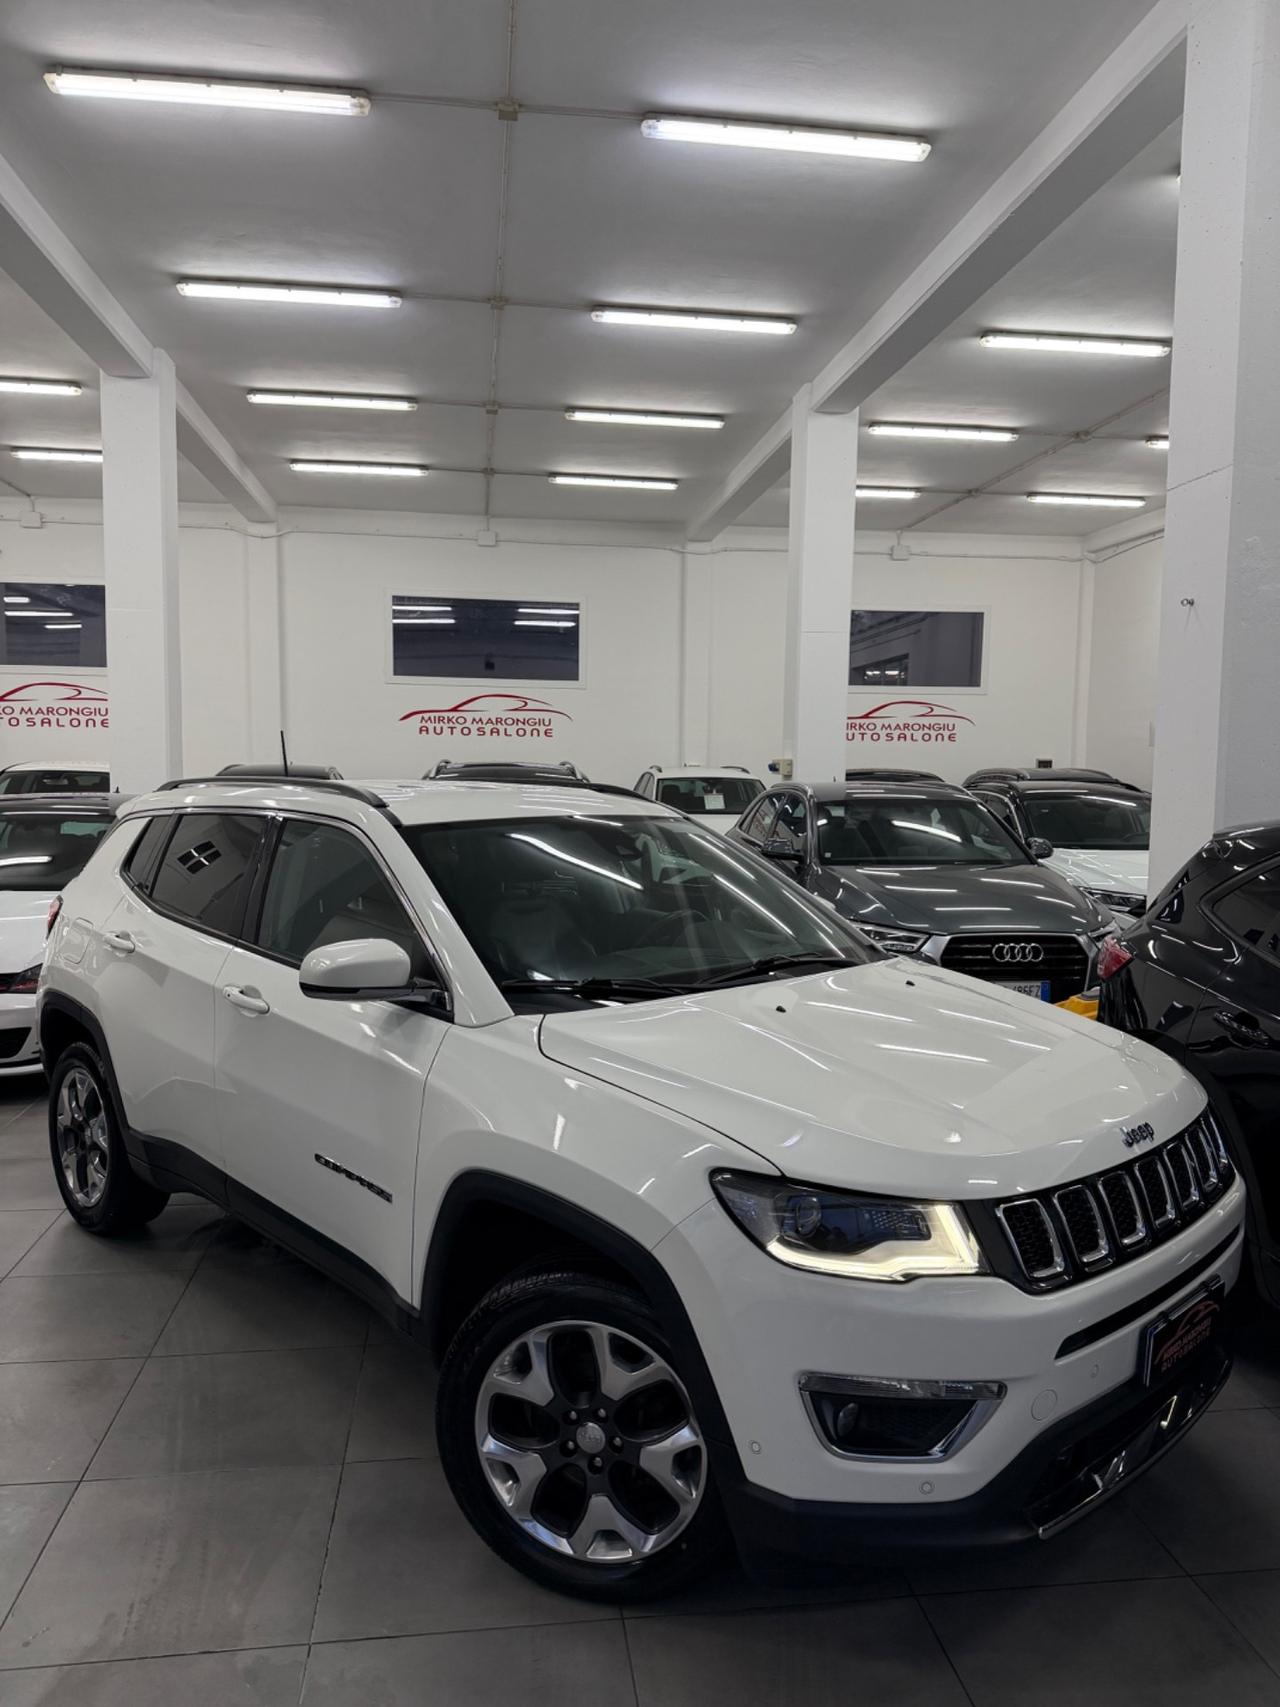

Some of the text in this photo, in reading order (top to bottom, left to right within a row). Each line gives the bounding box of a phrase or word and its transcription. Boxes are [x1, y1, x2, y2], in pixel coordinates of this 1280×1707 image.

[19, 706, 109, 717] MARONGIU
[419, 715, 552, 727] MIRKO MARONGIU
[418, 725, 554, 738] AUTOSALONE
[846, 722, 956, 732] IRKO MARONGIU
[846, 732, 957, 742] UTOSALONE
[1120, 1121, 1154, 1148] Jeep
